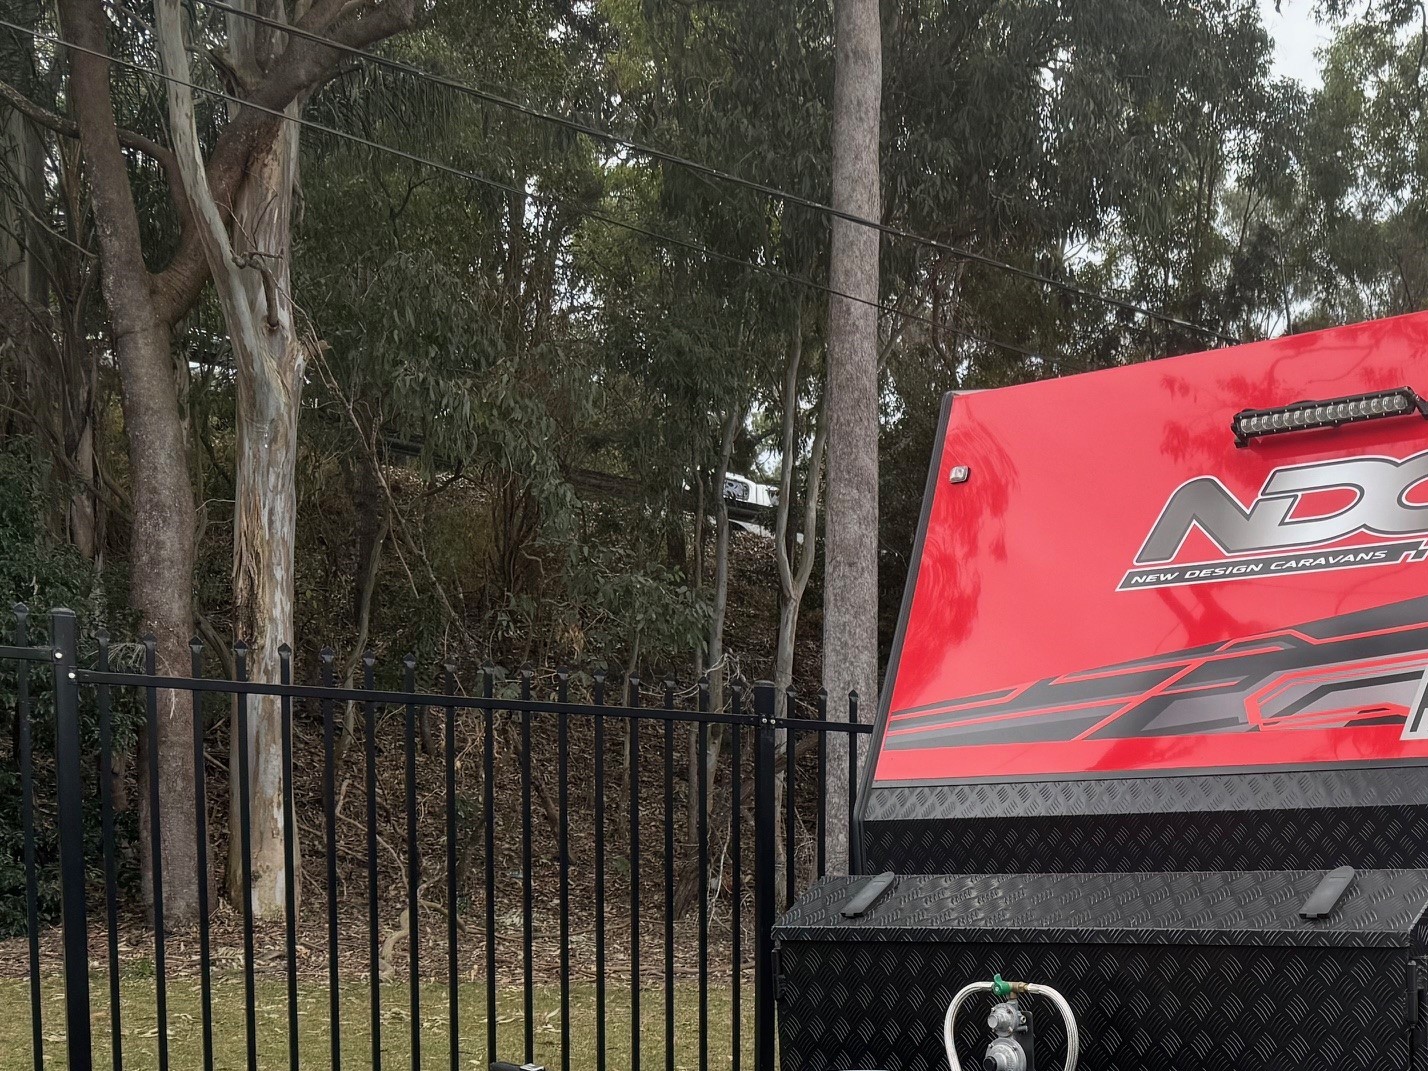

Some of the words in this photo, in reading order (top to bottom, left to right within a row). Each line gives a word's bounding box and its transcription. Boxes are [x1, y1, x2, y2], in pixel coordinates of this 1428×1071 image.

[1130, 571, 1180, 585] NEW
[1184, 563, 1264, 580] DESIGN
[1269, 550, 1388, 570] CARAVANS
